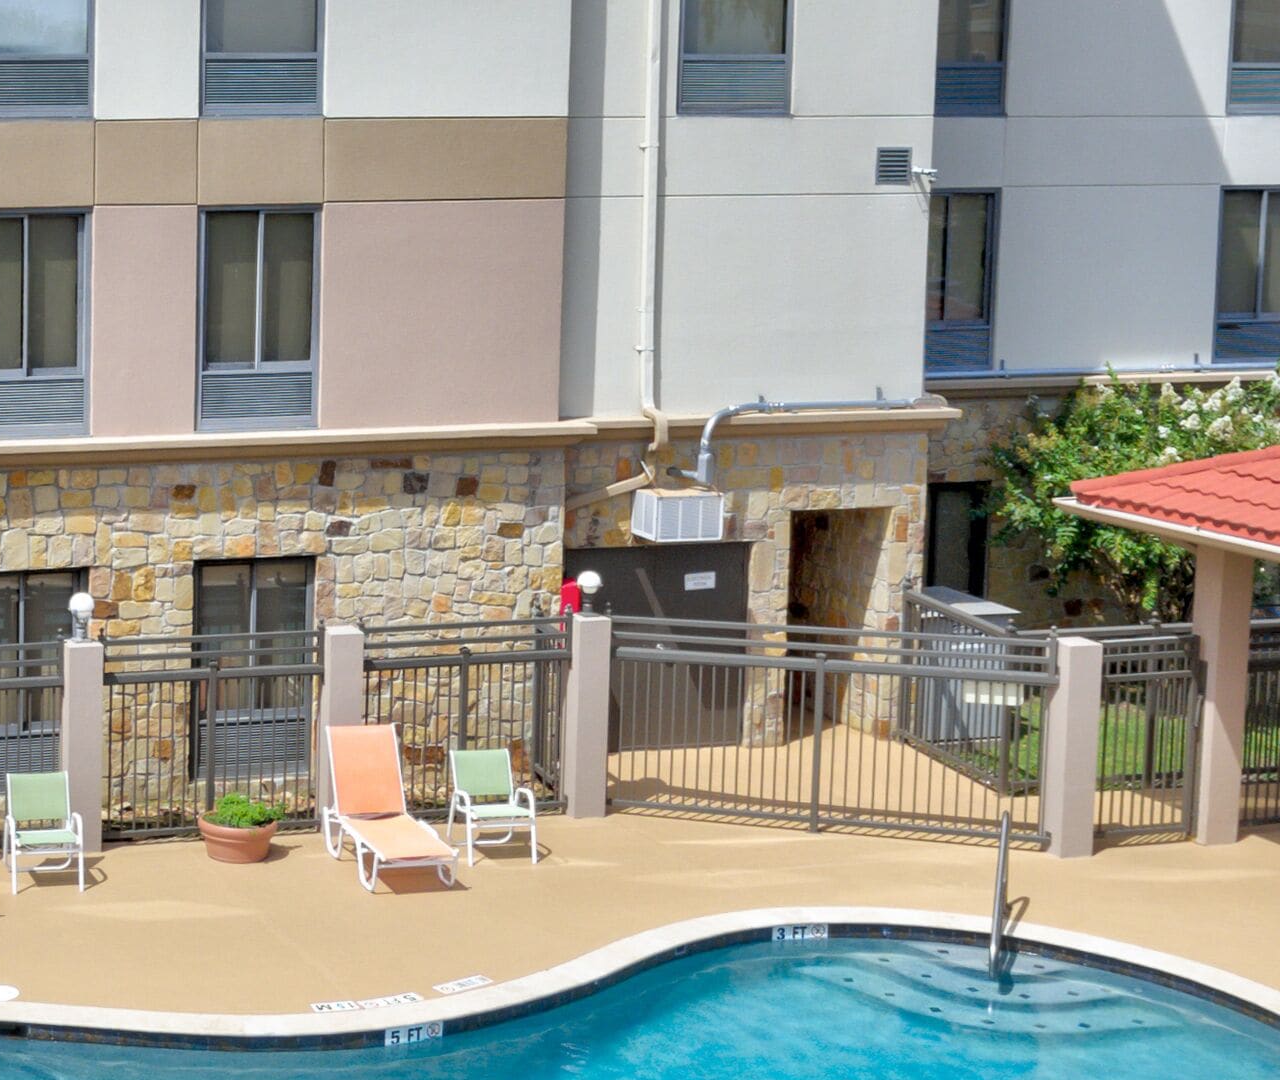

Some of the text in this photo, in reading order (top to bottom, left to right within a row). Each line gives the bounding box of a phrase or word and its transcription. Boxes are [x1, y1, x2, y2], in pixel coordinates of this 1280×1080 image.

[776, 926, 808, 940] 3 FT
[391, 1027, 422, 1045] 5 FT
